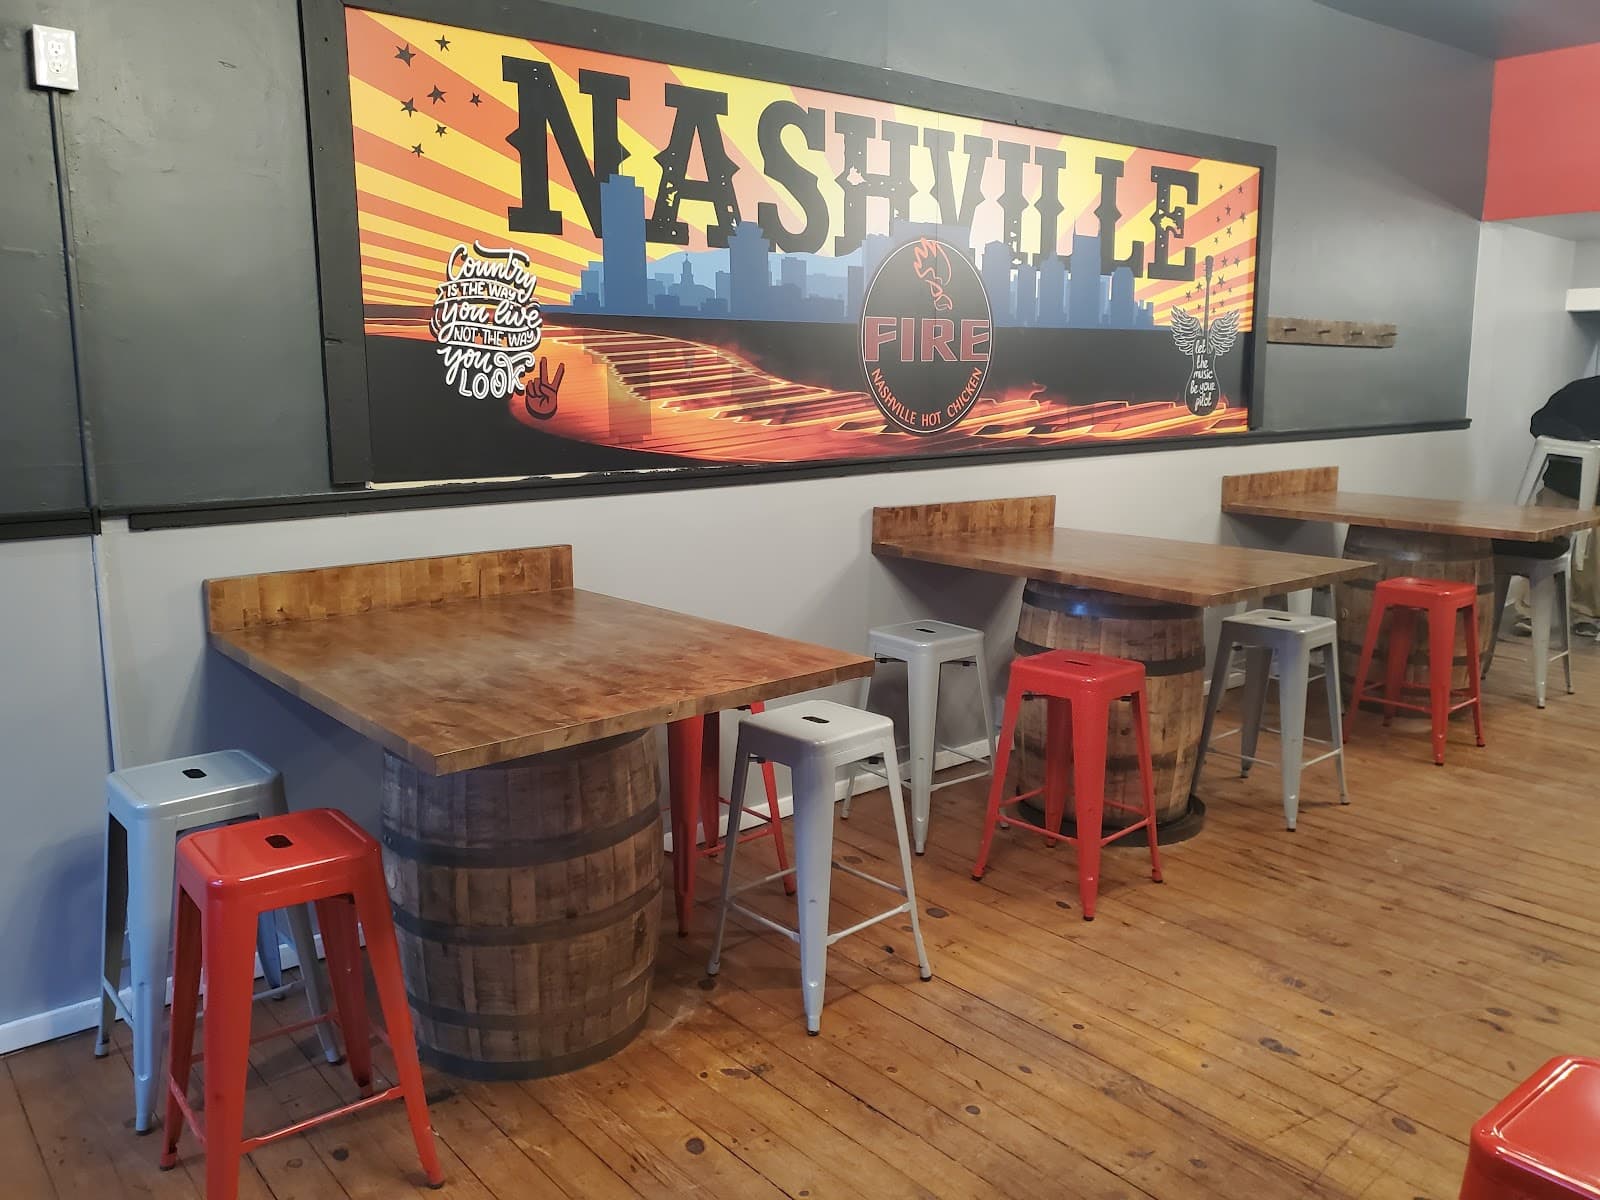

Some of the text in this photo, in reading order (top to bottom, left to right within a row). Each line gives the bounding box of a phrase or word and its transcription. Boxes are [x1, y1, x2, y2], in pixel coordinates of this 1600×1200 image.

[502, 55, 1199, 281] NASHVILLE
[448, 240, 537, 304] Country
[447, 282, 516, 300] IS THE WAY
[494, 300, 542, 328] live
[454, 327, 535, 347] NOT THE WAY
[863, 316, 991, 362] FIRE
[1195, 339, 1207, 354] let
[1196, 354, 1209, 369] the
[459, 352, 535, 399] LOOK
[1193, 368, 1214, 379] music
[871, 367, 983, 427] NASHVILLE HOT CHICKEN
[1199, 382, 1216, 394] your
[1194, 392, 1212, 412] pilot
